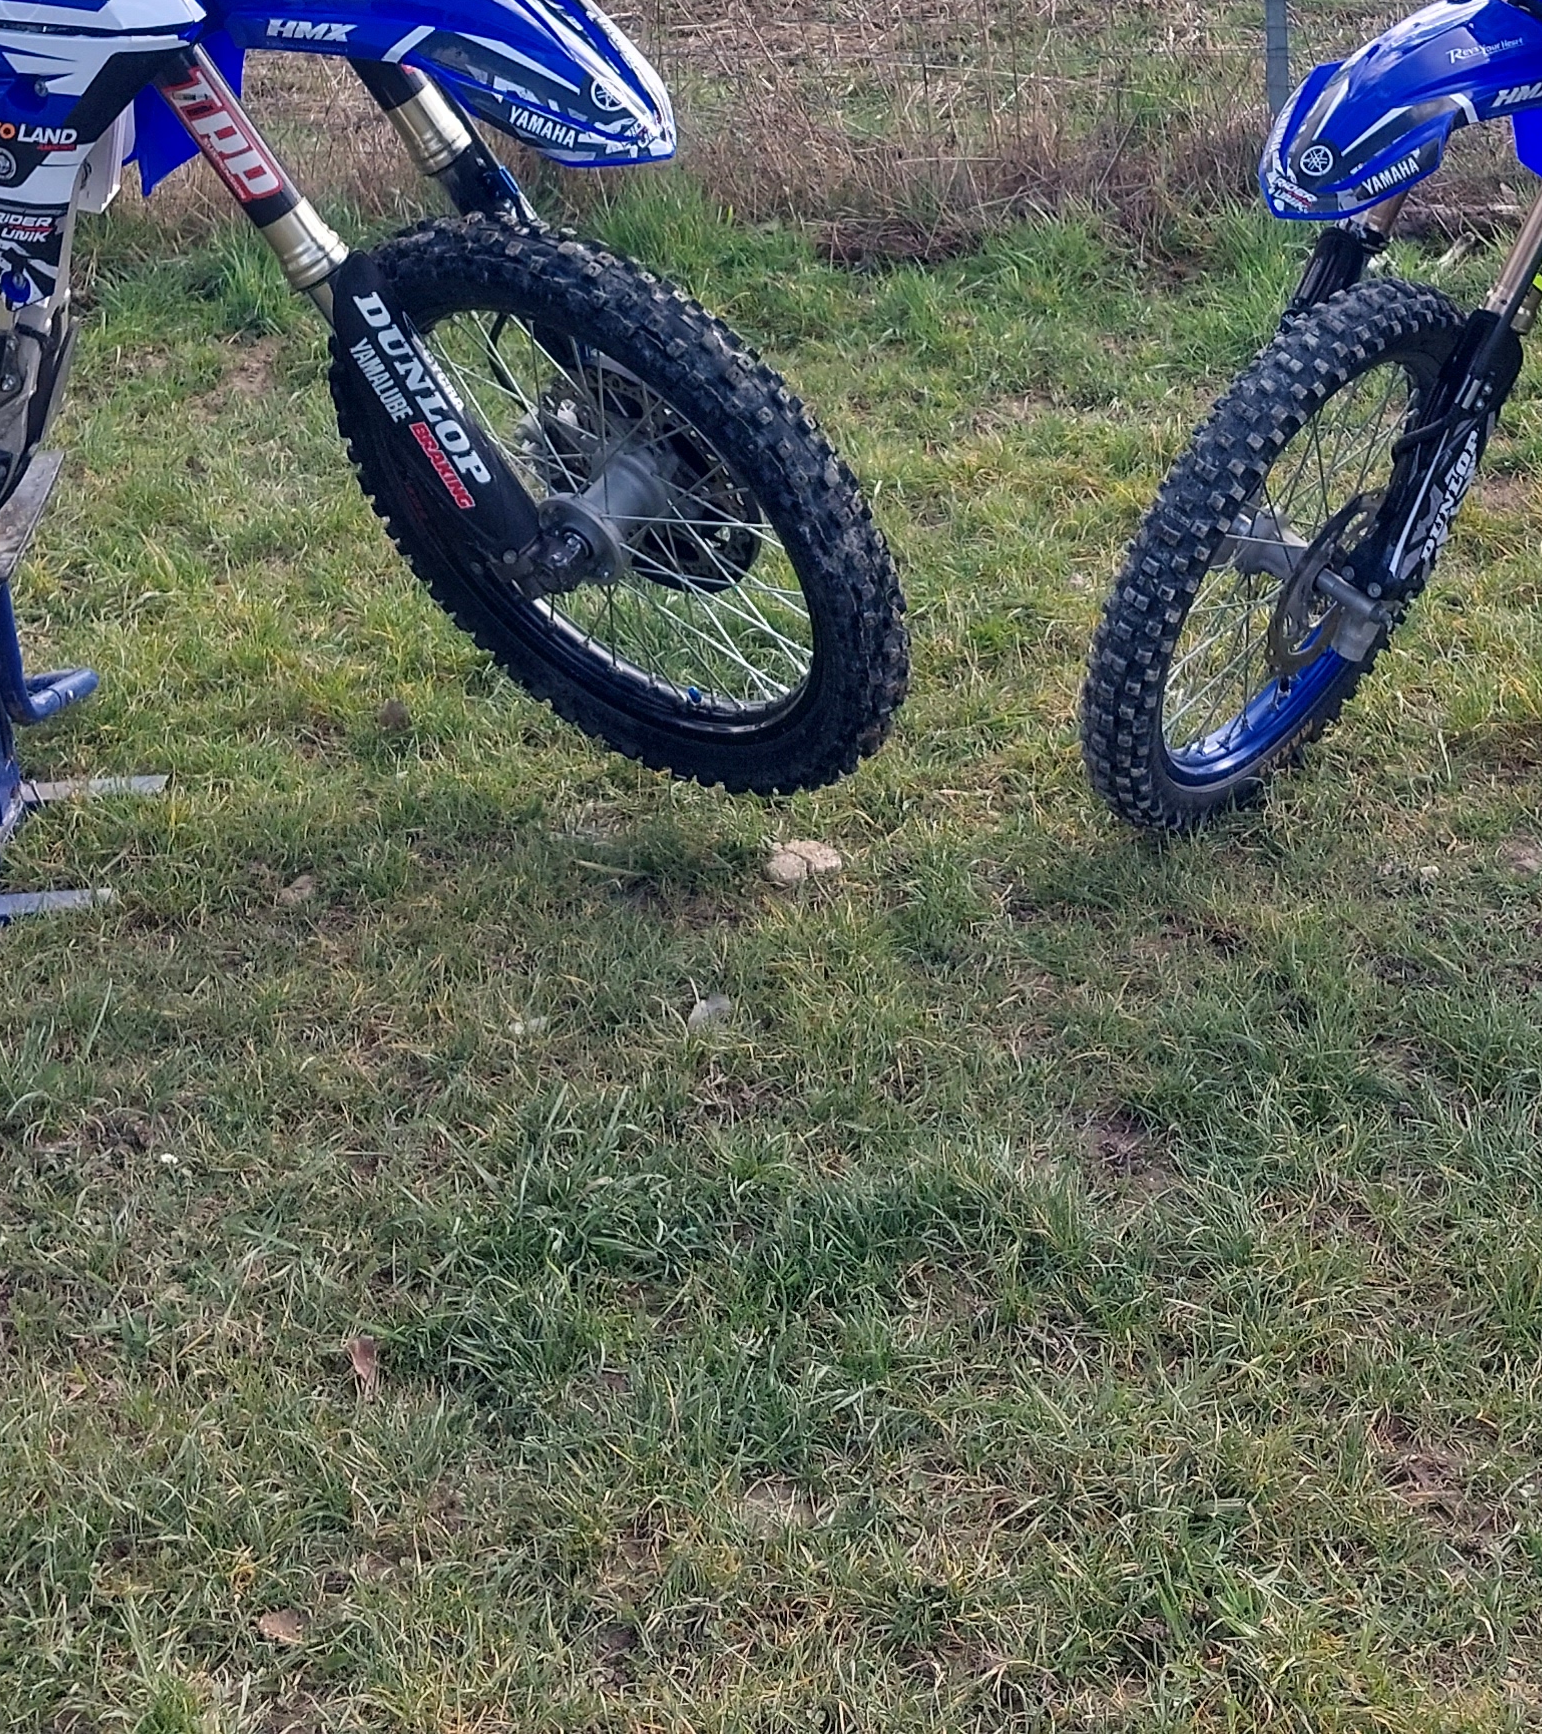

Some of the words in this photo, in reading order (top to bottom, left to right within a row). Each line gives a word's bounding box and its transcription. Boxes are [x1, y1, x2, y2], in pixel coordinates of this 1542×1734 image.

[265, 18, 359, 43] HMX
[17, 123, 78, 145] LAND
[508, 105, 576, 149] YAMAHA
[1362, 157, 1421, 196] YAMAHA
[0, 228, 49, 243] UNIK
[348, 336, 414, 424] YAMALUBE
[352, 291, 492, 485] DUNLOP
[408, 420, 476, 510] BRAKING
[1420, 429, 1480, 561] DUNLOP
